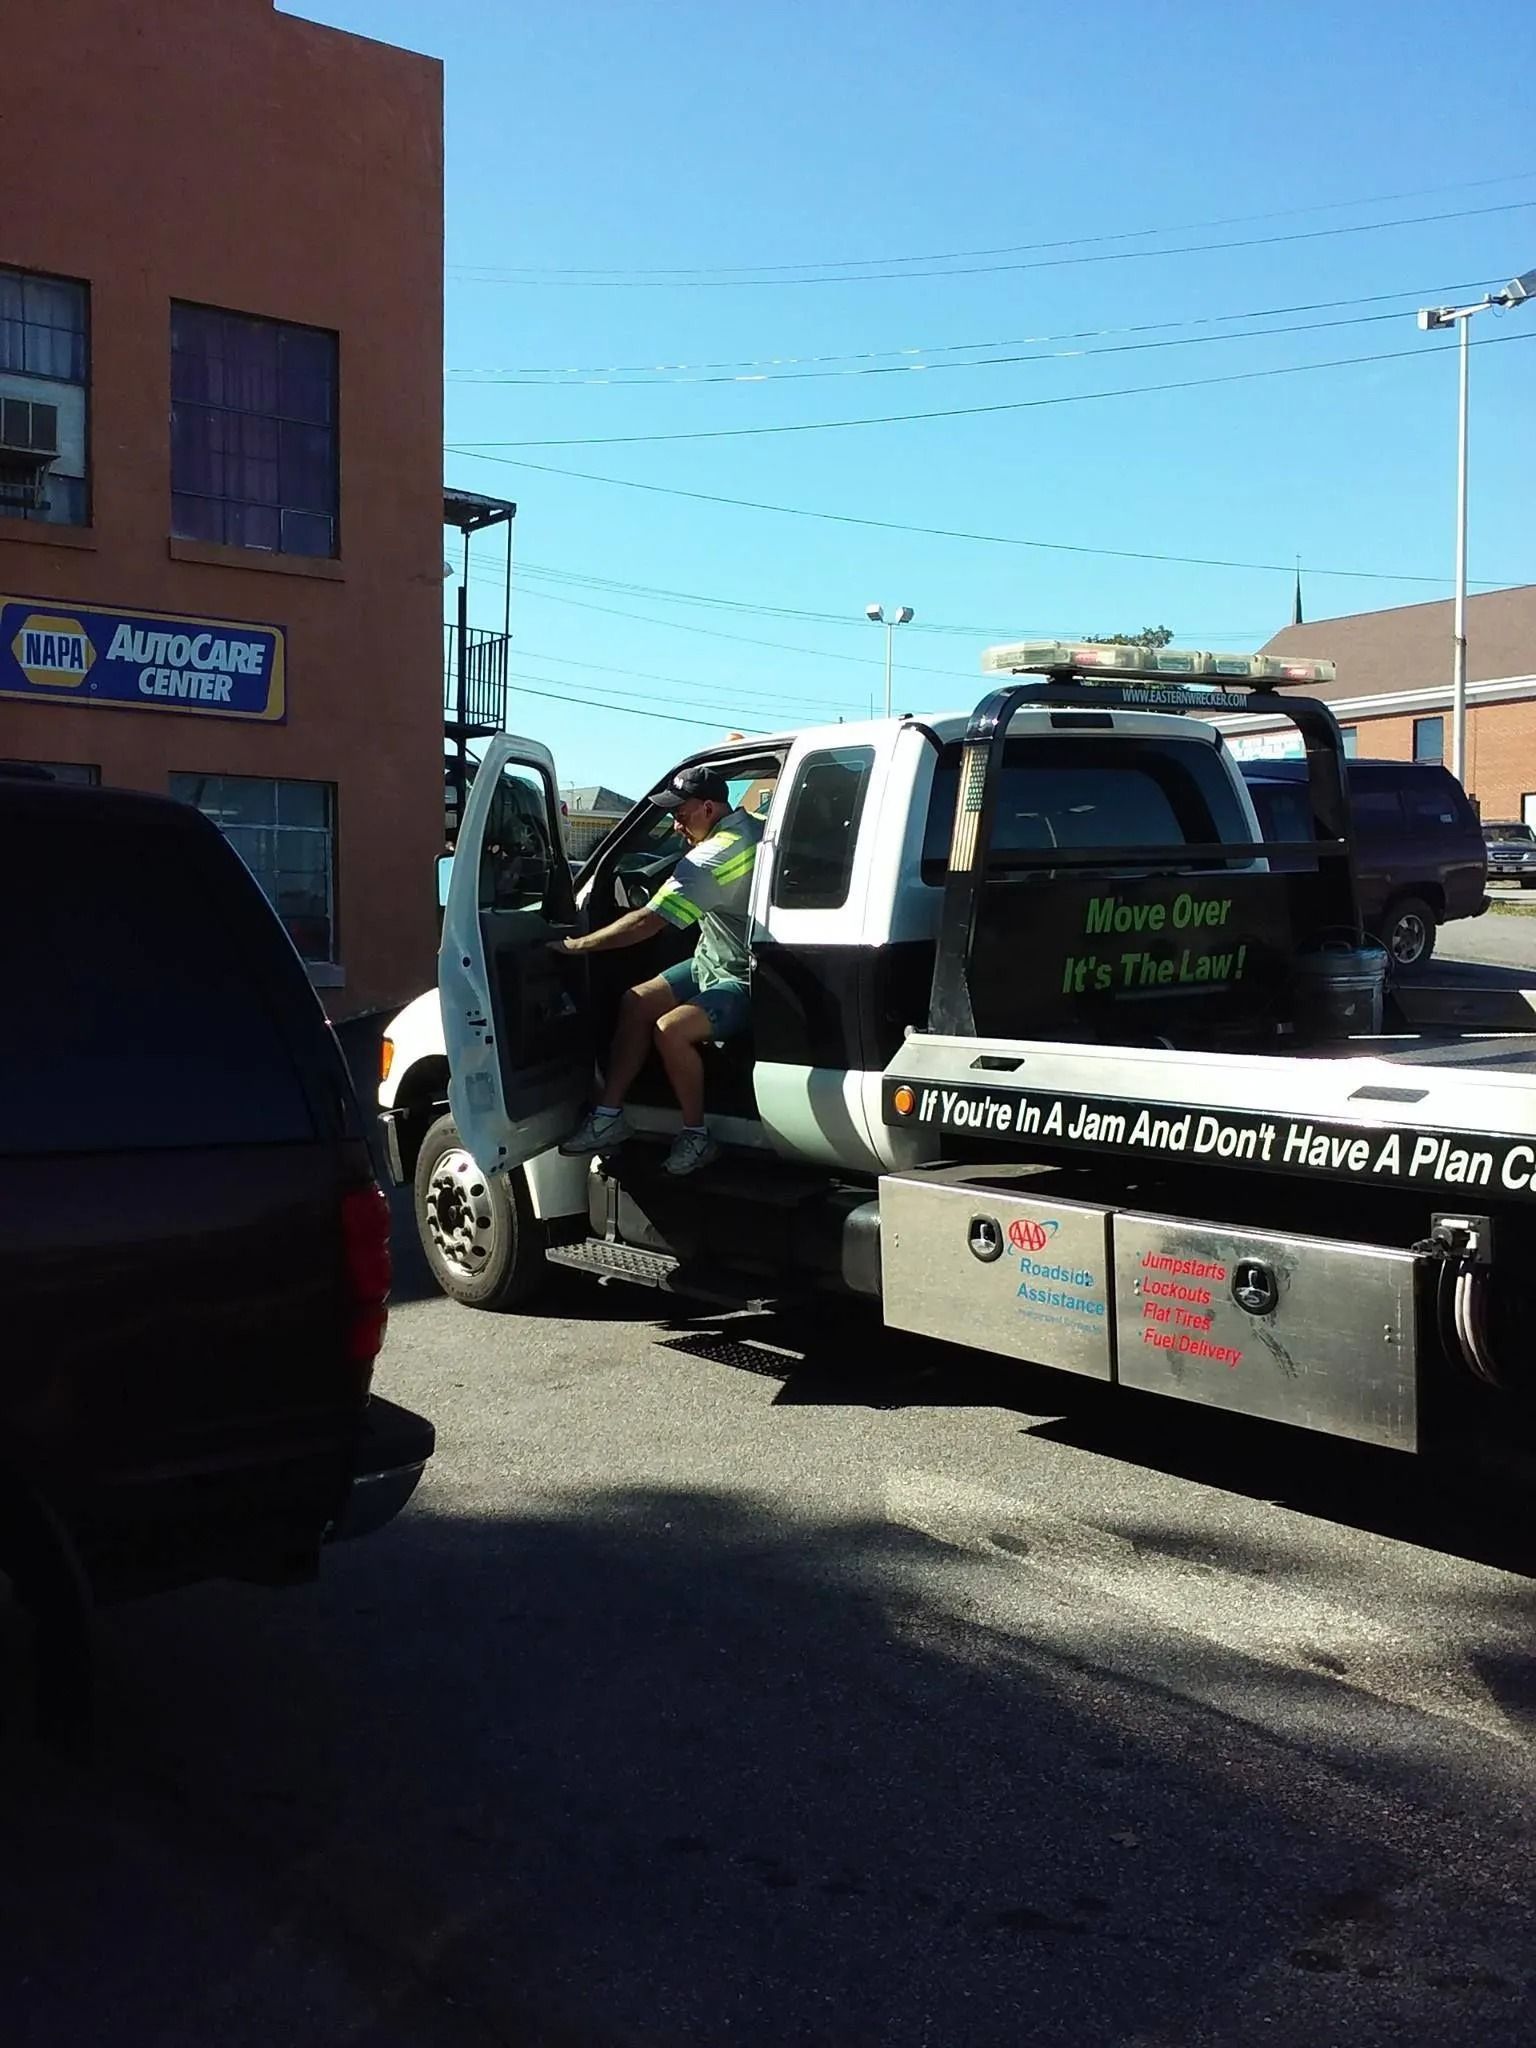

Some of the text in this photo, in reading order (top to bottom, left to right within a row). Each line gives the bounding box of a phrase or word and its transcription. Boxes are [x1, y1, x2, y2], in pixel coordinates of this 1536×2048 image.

[26, 633, 84, 670] NAPA
[138, 667, 233, 702] CENTER
[1122, 687, 1248, 707] WWW.EASTERNWRECKER.COM
[1086, 893, 1231, 934] Move Over
[1061, 956, 1113, 994] It's
[1119, 949, 1174, 987] The
[918, 1088, 939, 1122] If
[941, 1089, 1012, 1131] You're
[1014, 1098, 1041, 1134] In
[1042, 1101, 1063, 1137] A
[1067, 1104, 1126, 1145] Jam
[1127, 1110, 1192, 1151] And
[1193, 1115, 1276, 1161] Don't
[1282, 1123, 1370, 1171] Have
[1372, 1133, 1400, 1175] A
[1408, 1136, 1493, 1185] Plan
[1010, 1220, 1046, 1251] AAA
[1020, 1257, 1094, 1287] Roadside
[1141, 1251, 1227, 1281] Jumpstarts
[1017, 1282, 1105, 1316] Assistance
[1143, 1276, 1211, 1304] Lockouts
[1143, 1302, 1212, 1331] Flat Tires
[1143, 1327, 1243, 1368] Fuel Delivery
